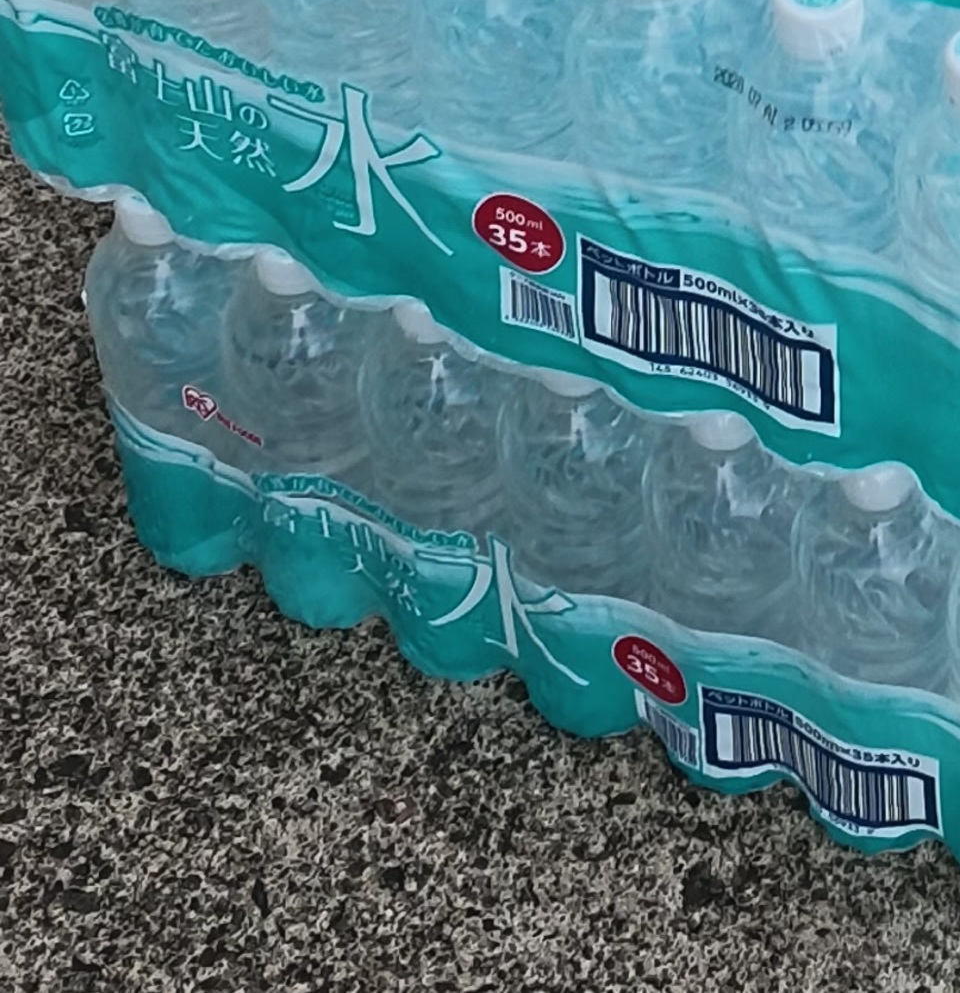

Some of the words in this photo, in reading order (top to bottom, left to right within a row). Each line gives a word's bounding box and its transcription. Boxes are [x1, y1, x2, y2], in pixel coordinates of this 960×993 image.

[174, 113, 277, 179] 天然
[268, 83, 454, 256] 水
[495, 206, 544, 232] 500ml
[488, 223, 552, 259] 35本
[586, 244, 674, 285] ペットボトル
[413, 533, 589, 687] 水
[707, 689, 790, 719] ペットボトル
